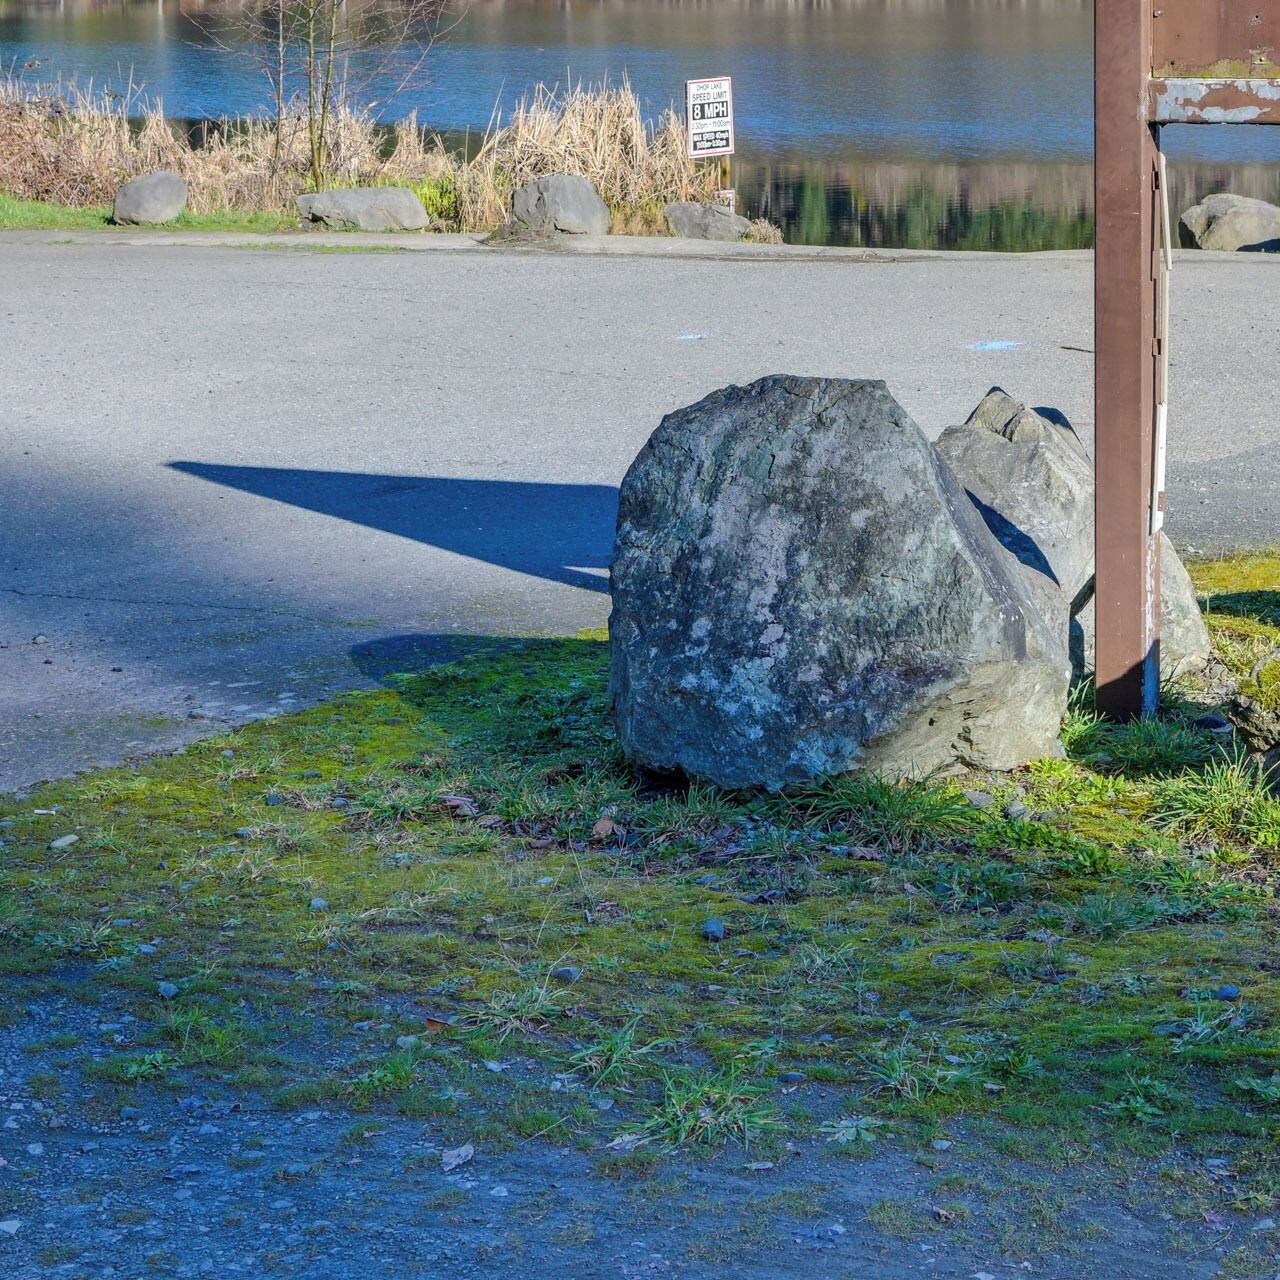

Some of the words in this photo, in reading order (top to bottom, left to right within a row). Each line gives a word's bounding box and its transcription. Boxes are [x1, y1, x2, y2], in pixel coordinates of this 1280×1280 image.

[692, 93, 710, 102] SPEED
[713, 91, 727, 100] LIMIT
[694, 104, 701, 119] 8
[704, 102, 727, 119] MPH
